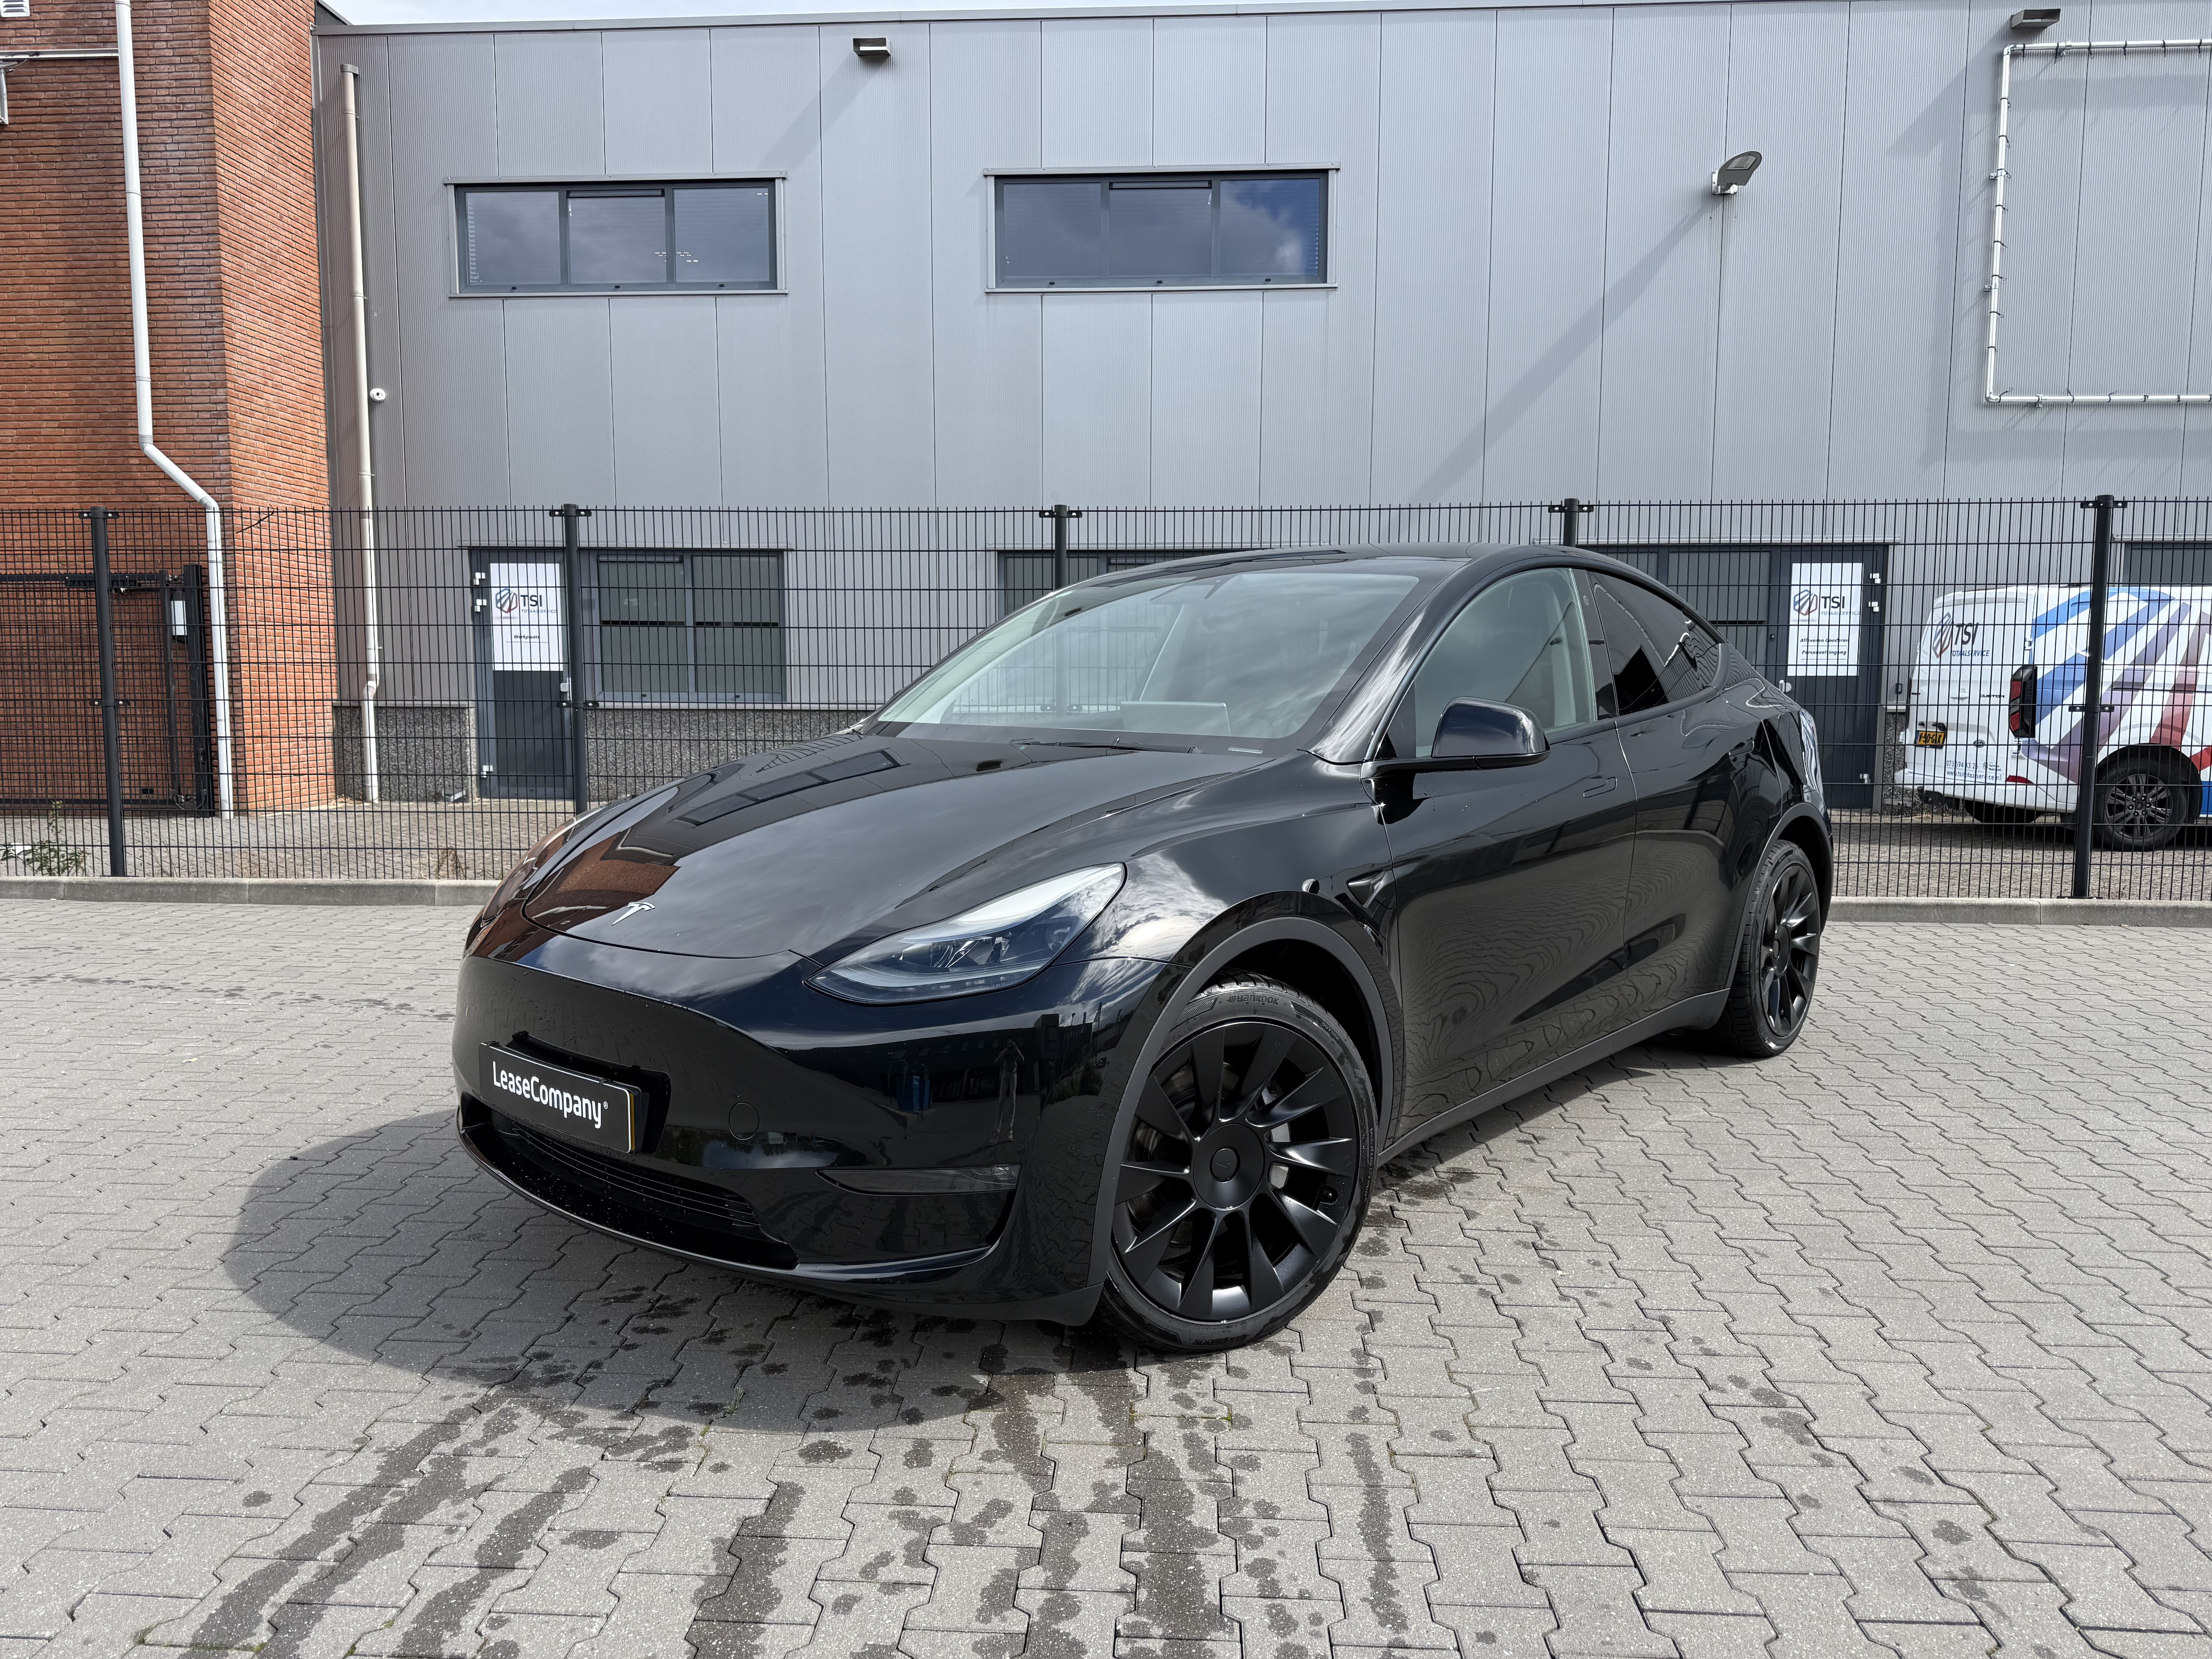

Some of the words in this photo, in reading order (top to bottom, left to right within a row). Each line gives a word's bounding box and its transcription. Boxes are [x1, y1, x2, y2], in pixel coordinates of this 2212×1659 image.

[520, 595, 542, 607] TSI
[1821, 596, 1845, 609] TSI
[1954, 622, 1979, 645] TSI
